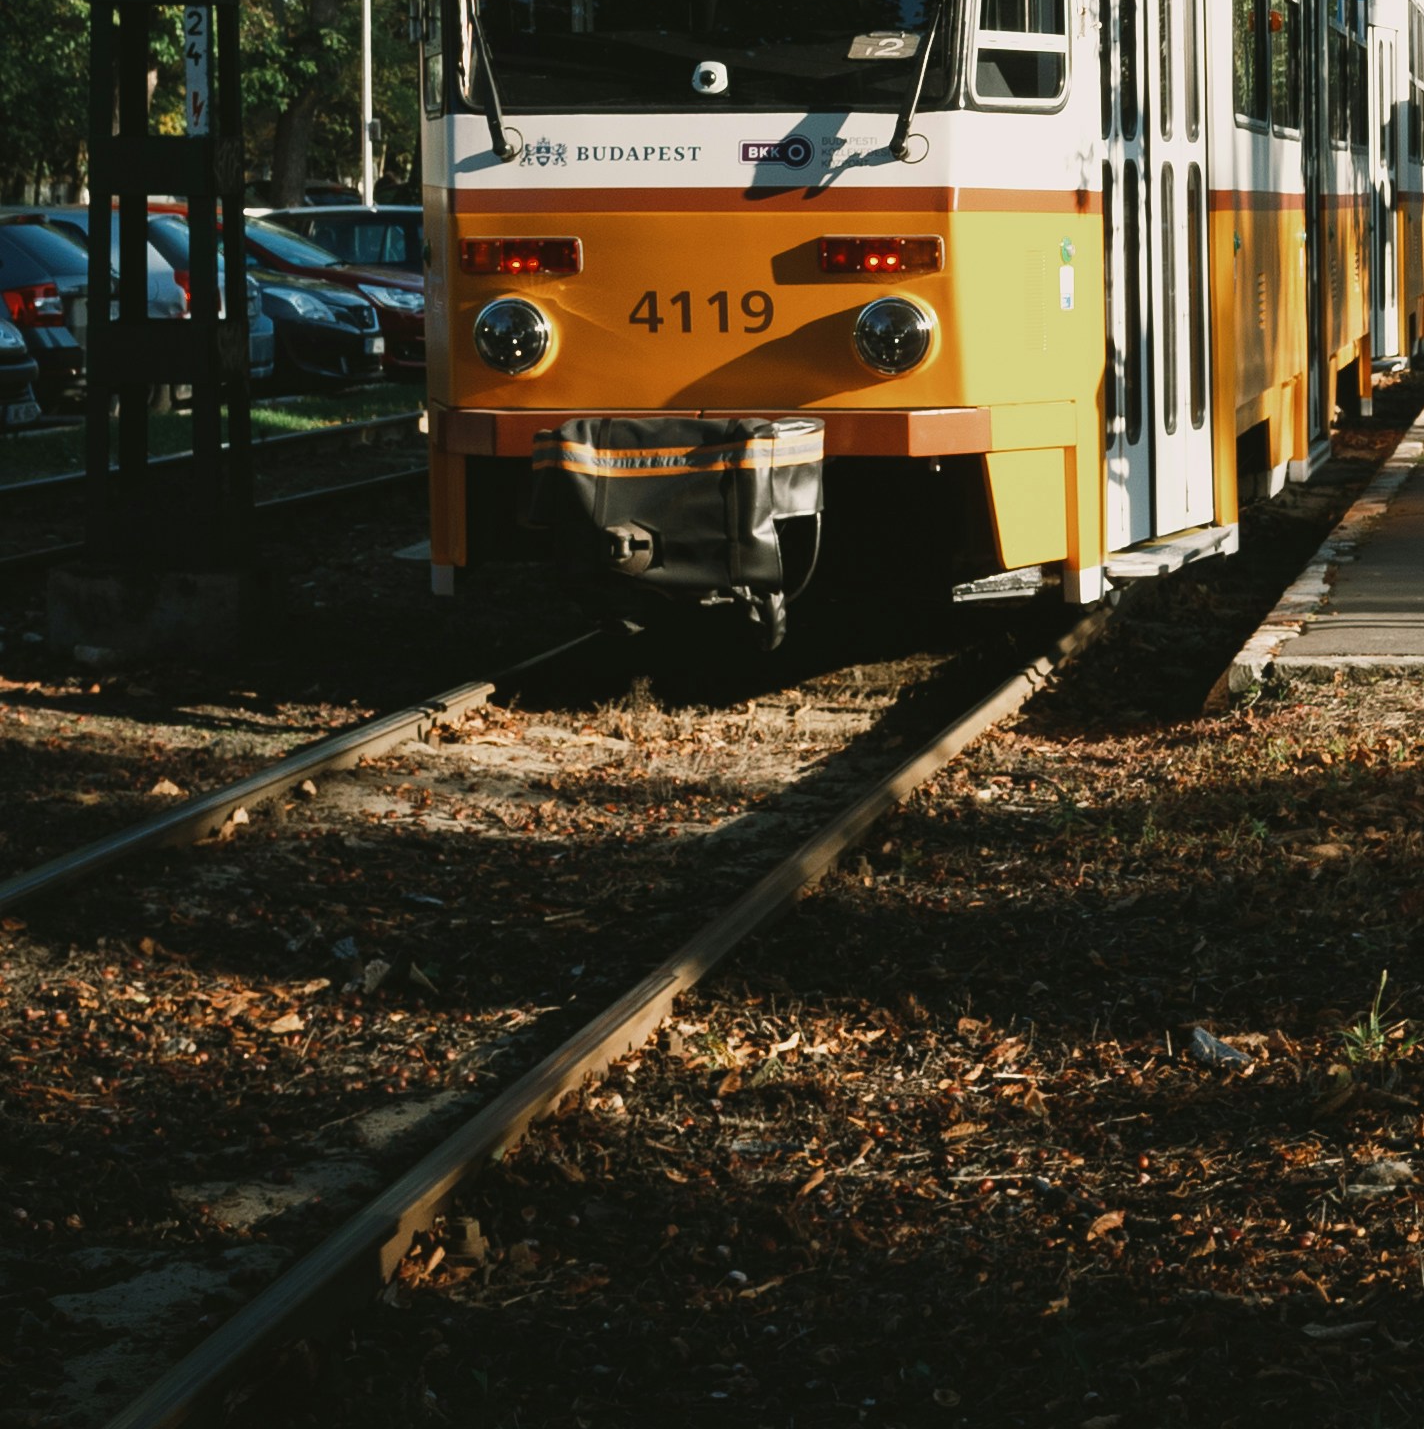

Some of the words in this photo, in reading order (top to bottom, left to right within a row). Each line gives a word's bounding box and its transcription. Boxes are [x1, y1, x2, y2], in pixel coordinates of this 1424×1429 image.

[821, 136, 878, 146] BUDAPESTI
[576, 146, 702, 162] BUDAPEST
[748, 146, 780, 159] BKK
[629, 290, 774, 333] 4119
